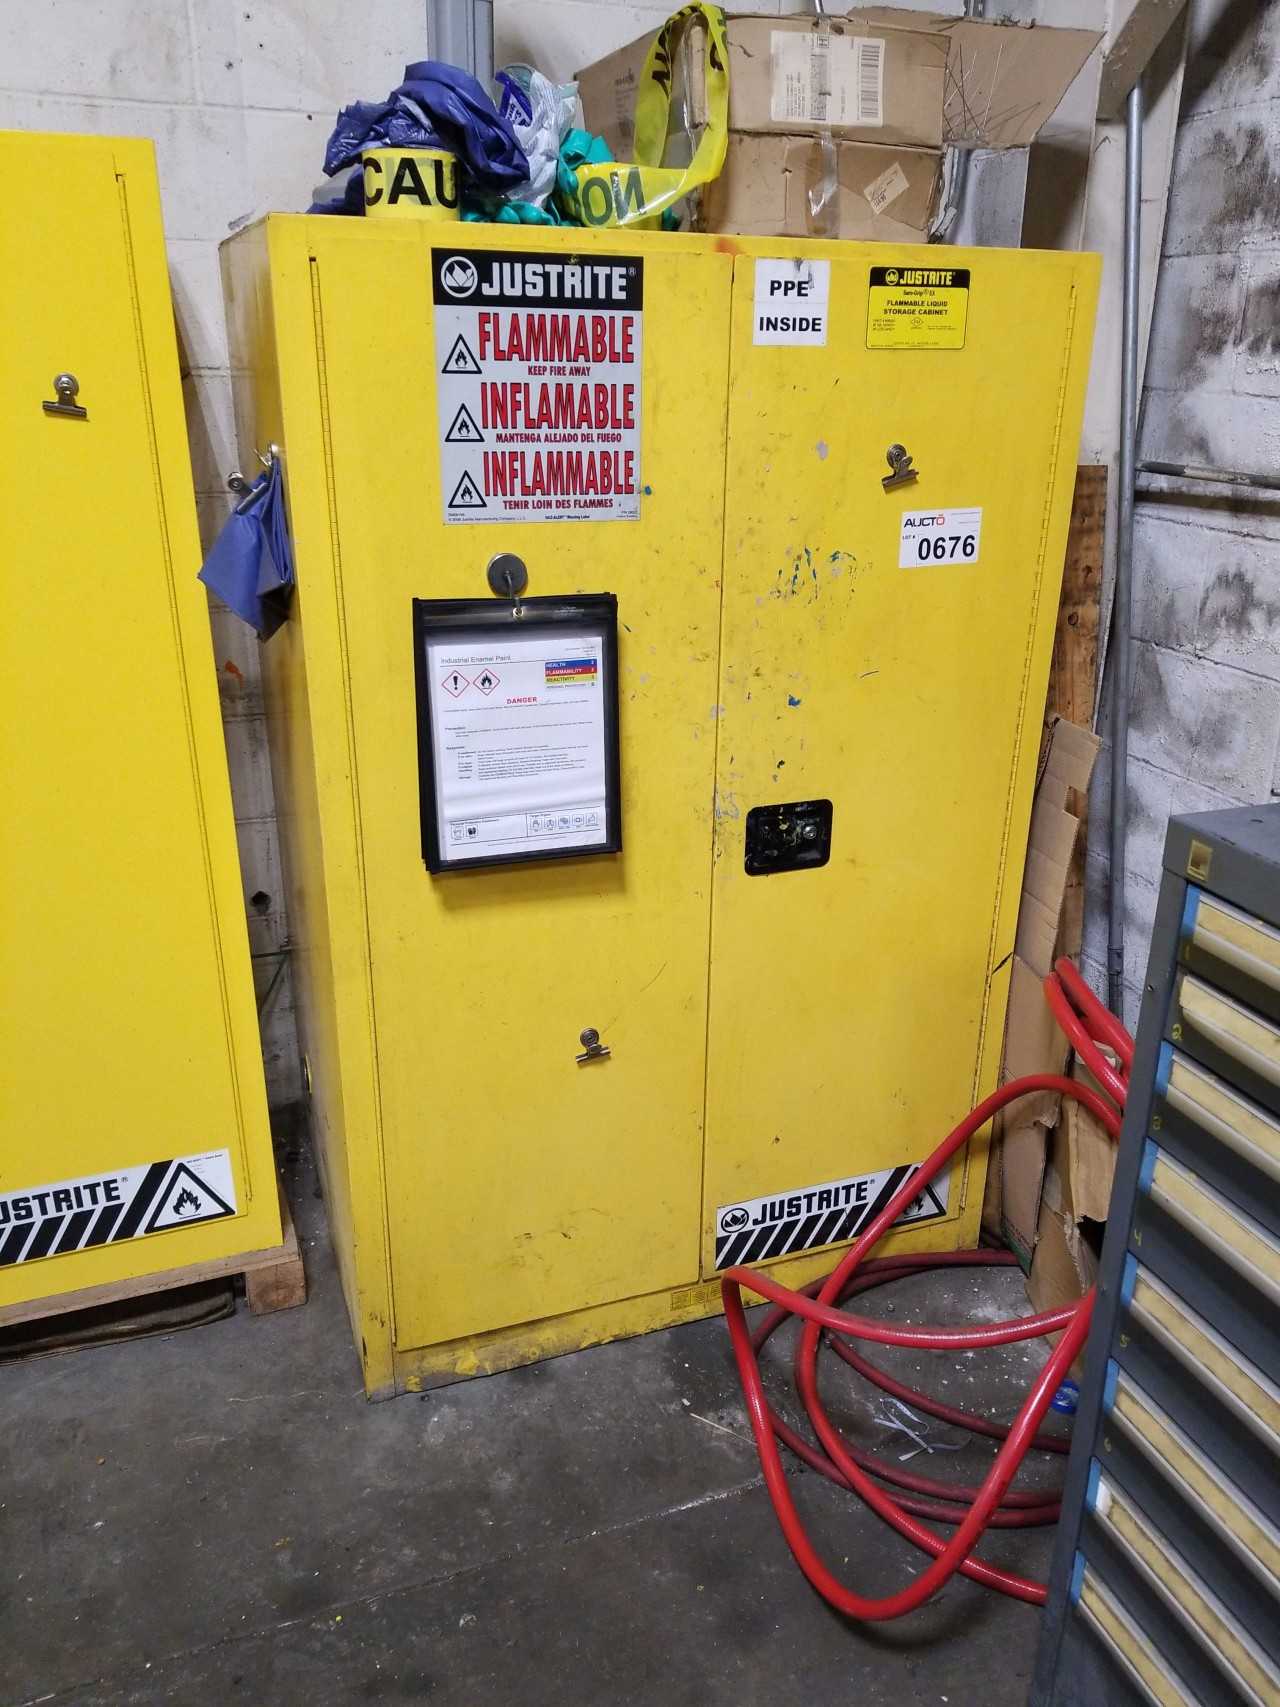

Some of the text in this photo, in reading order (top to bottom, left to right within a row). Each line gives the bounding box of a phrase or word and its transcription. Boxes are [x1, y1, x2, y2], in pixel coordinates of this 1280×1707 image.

[769, 280, 809, 297] PPE
[759, 317, 822, 332] INSIDE
[478, 312, 635, 364] FLAMMABLE
[528, 366, 591, 377] KEEP FIRE AWAY
[481, 382, 635, 429] INFLAMABLE
[496, 433, 622, 443] MANTENGA ALEJADO DEL FUEGO
[483, 451, 635, 496] INFLAMMABLE
[503, 498, 613, 510] TENIR LOIN DES FLAMMES
[918, 534, 976, 561] 0676
[440, 656, 469, 665] Industrial
